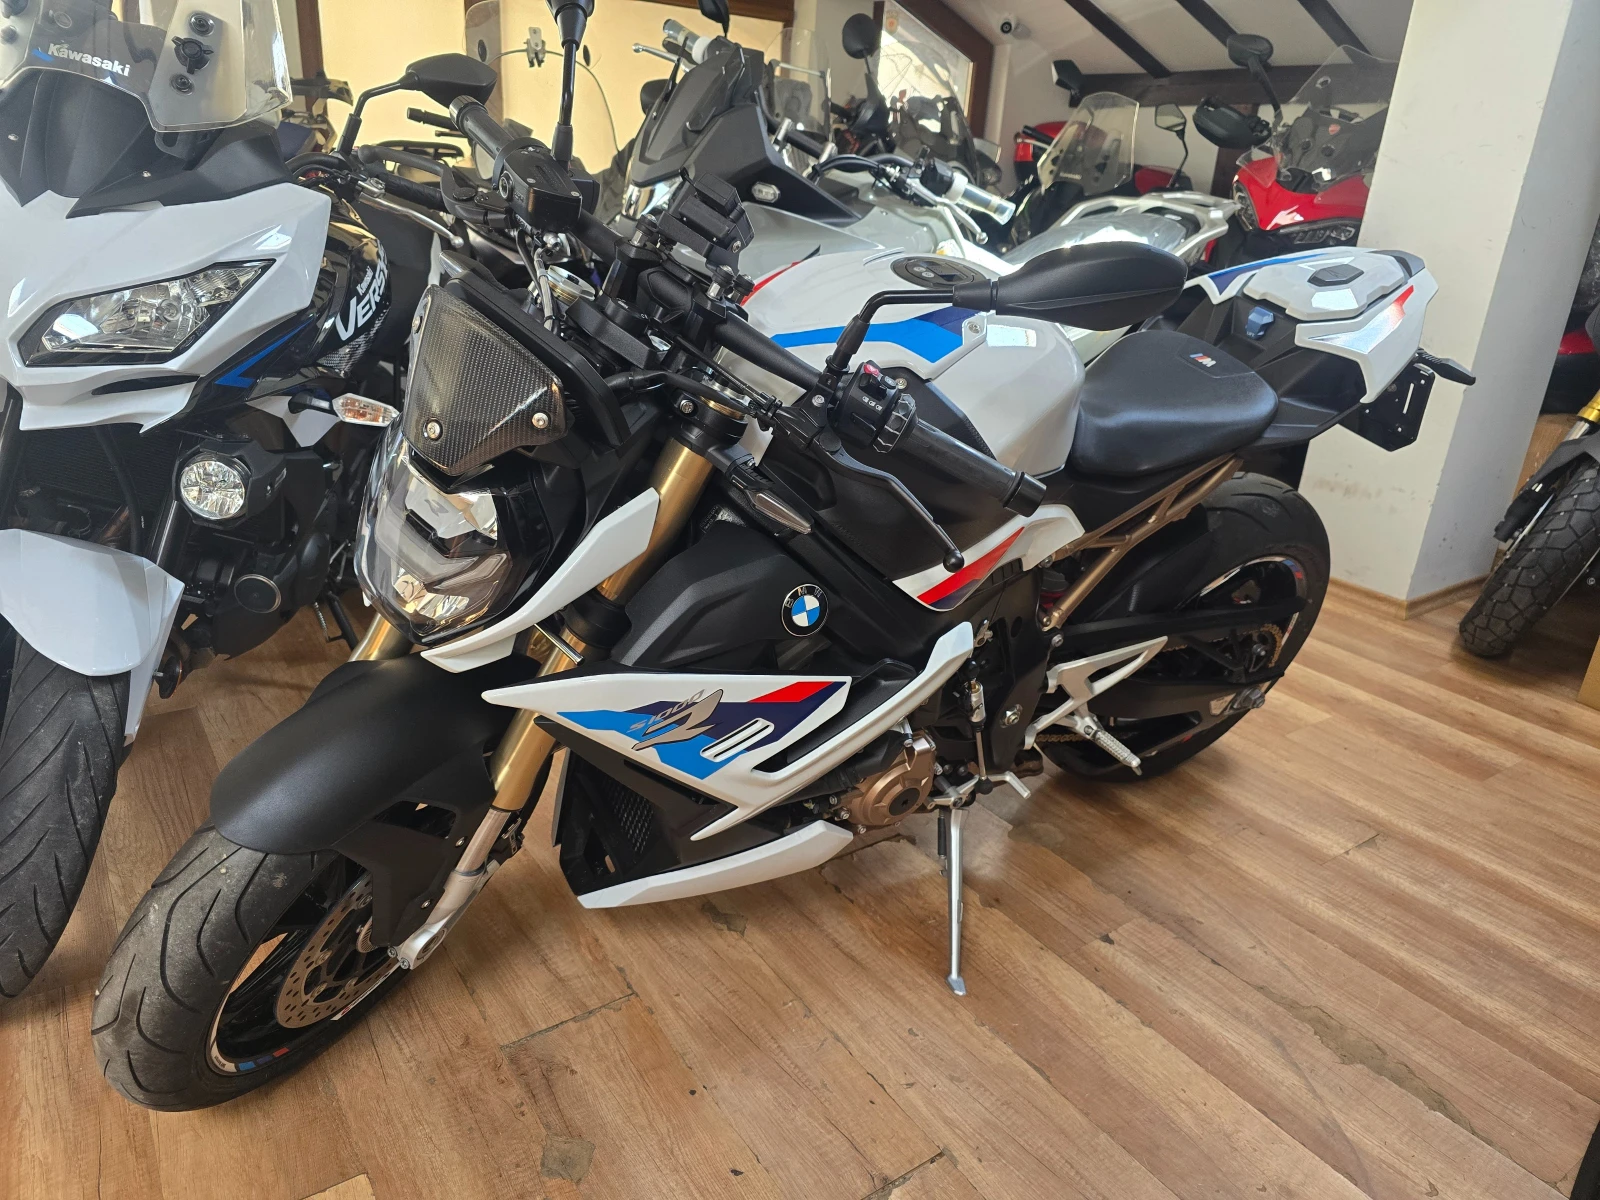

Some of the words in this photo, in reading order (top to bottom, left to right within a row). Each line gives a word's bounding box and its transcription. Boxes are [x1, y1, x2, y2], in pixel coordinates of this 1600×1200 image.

[47, 42, 131, 77] Kawasaki
[784, 585, 825, 609] BMW
[626, 688, 706, 734] S1000
